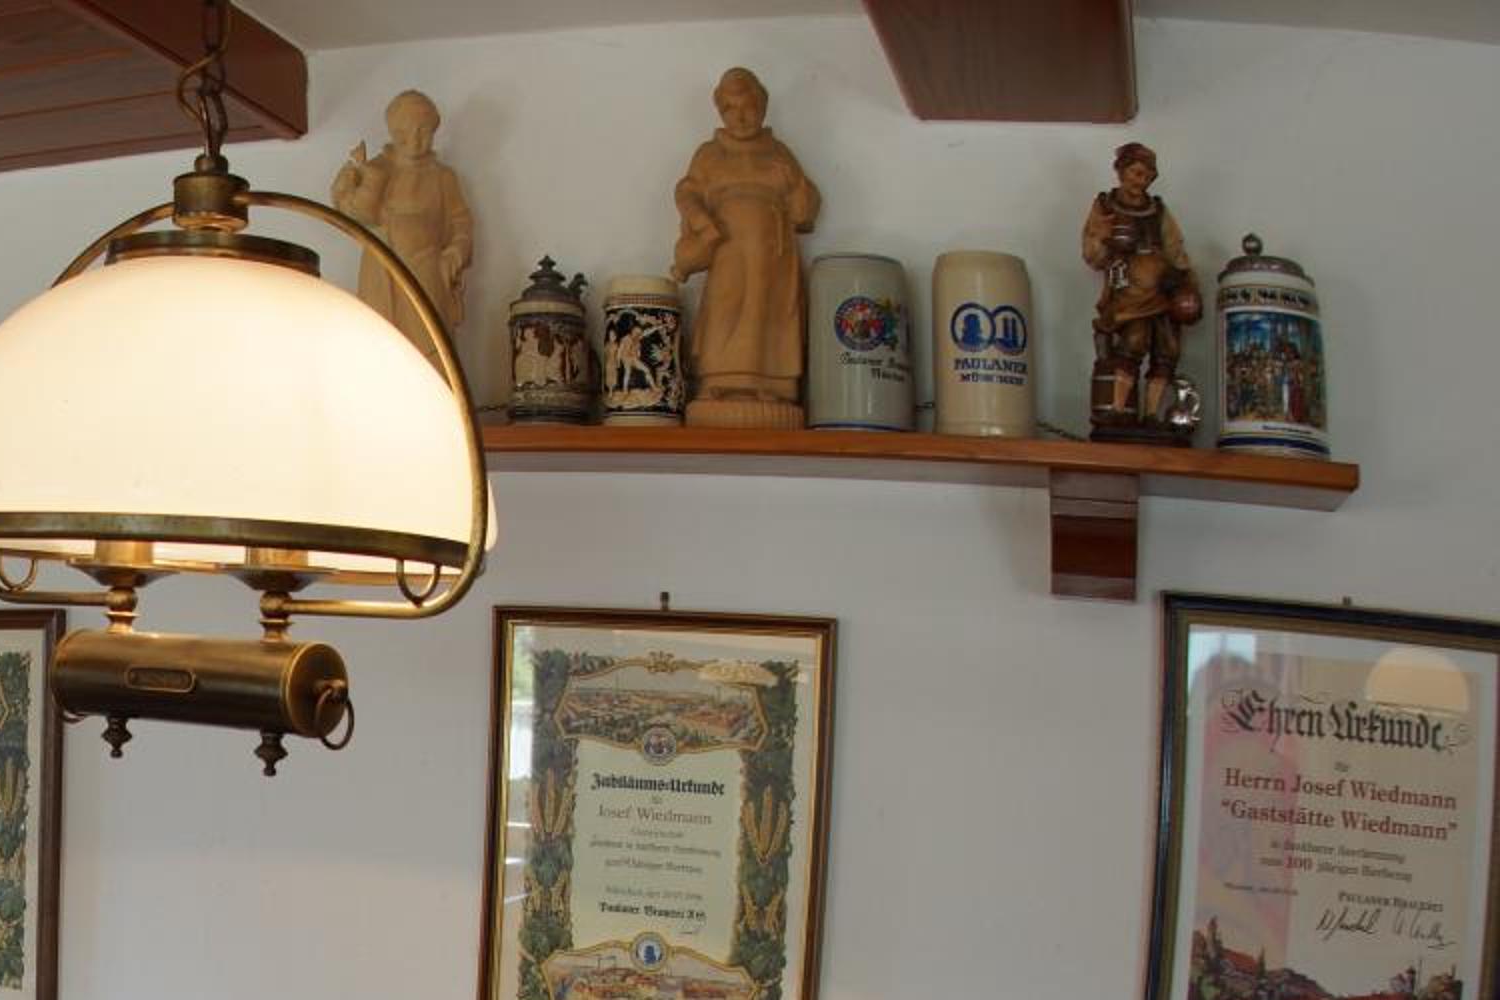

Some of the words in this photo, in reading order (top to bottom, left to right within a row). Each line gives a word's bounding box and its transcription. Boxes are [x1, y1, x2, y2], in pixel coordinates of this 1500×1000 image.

[1228, 690, 1325, 752] Ehren
[1328, 702, 1446, 751] Urkunde
[1225, 767, 1285, 792] Herrn
[1290, 774, 1345, 798] Josef
[1350, 781, 1457, 811] Wiedmann
[597, 803, 632, 819] Josef
[636, 806, 712, 825] Wiedmann
[1285, 855, 1313, 871] 100
